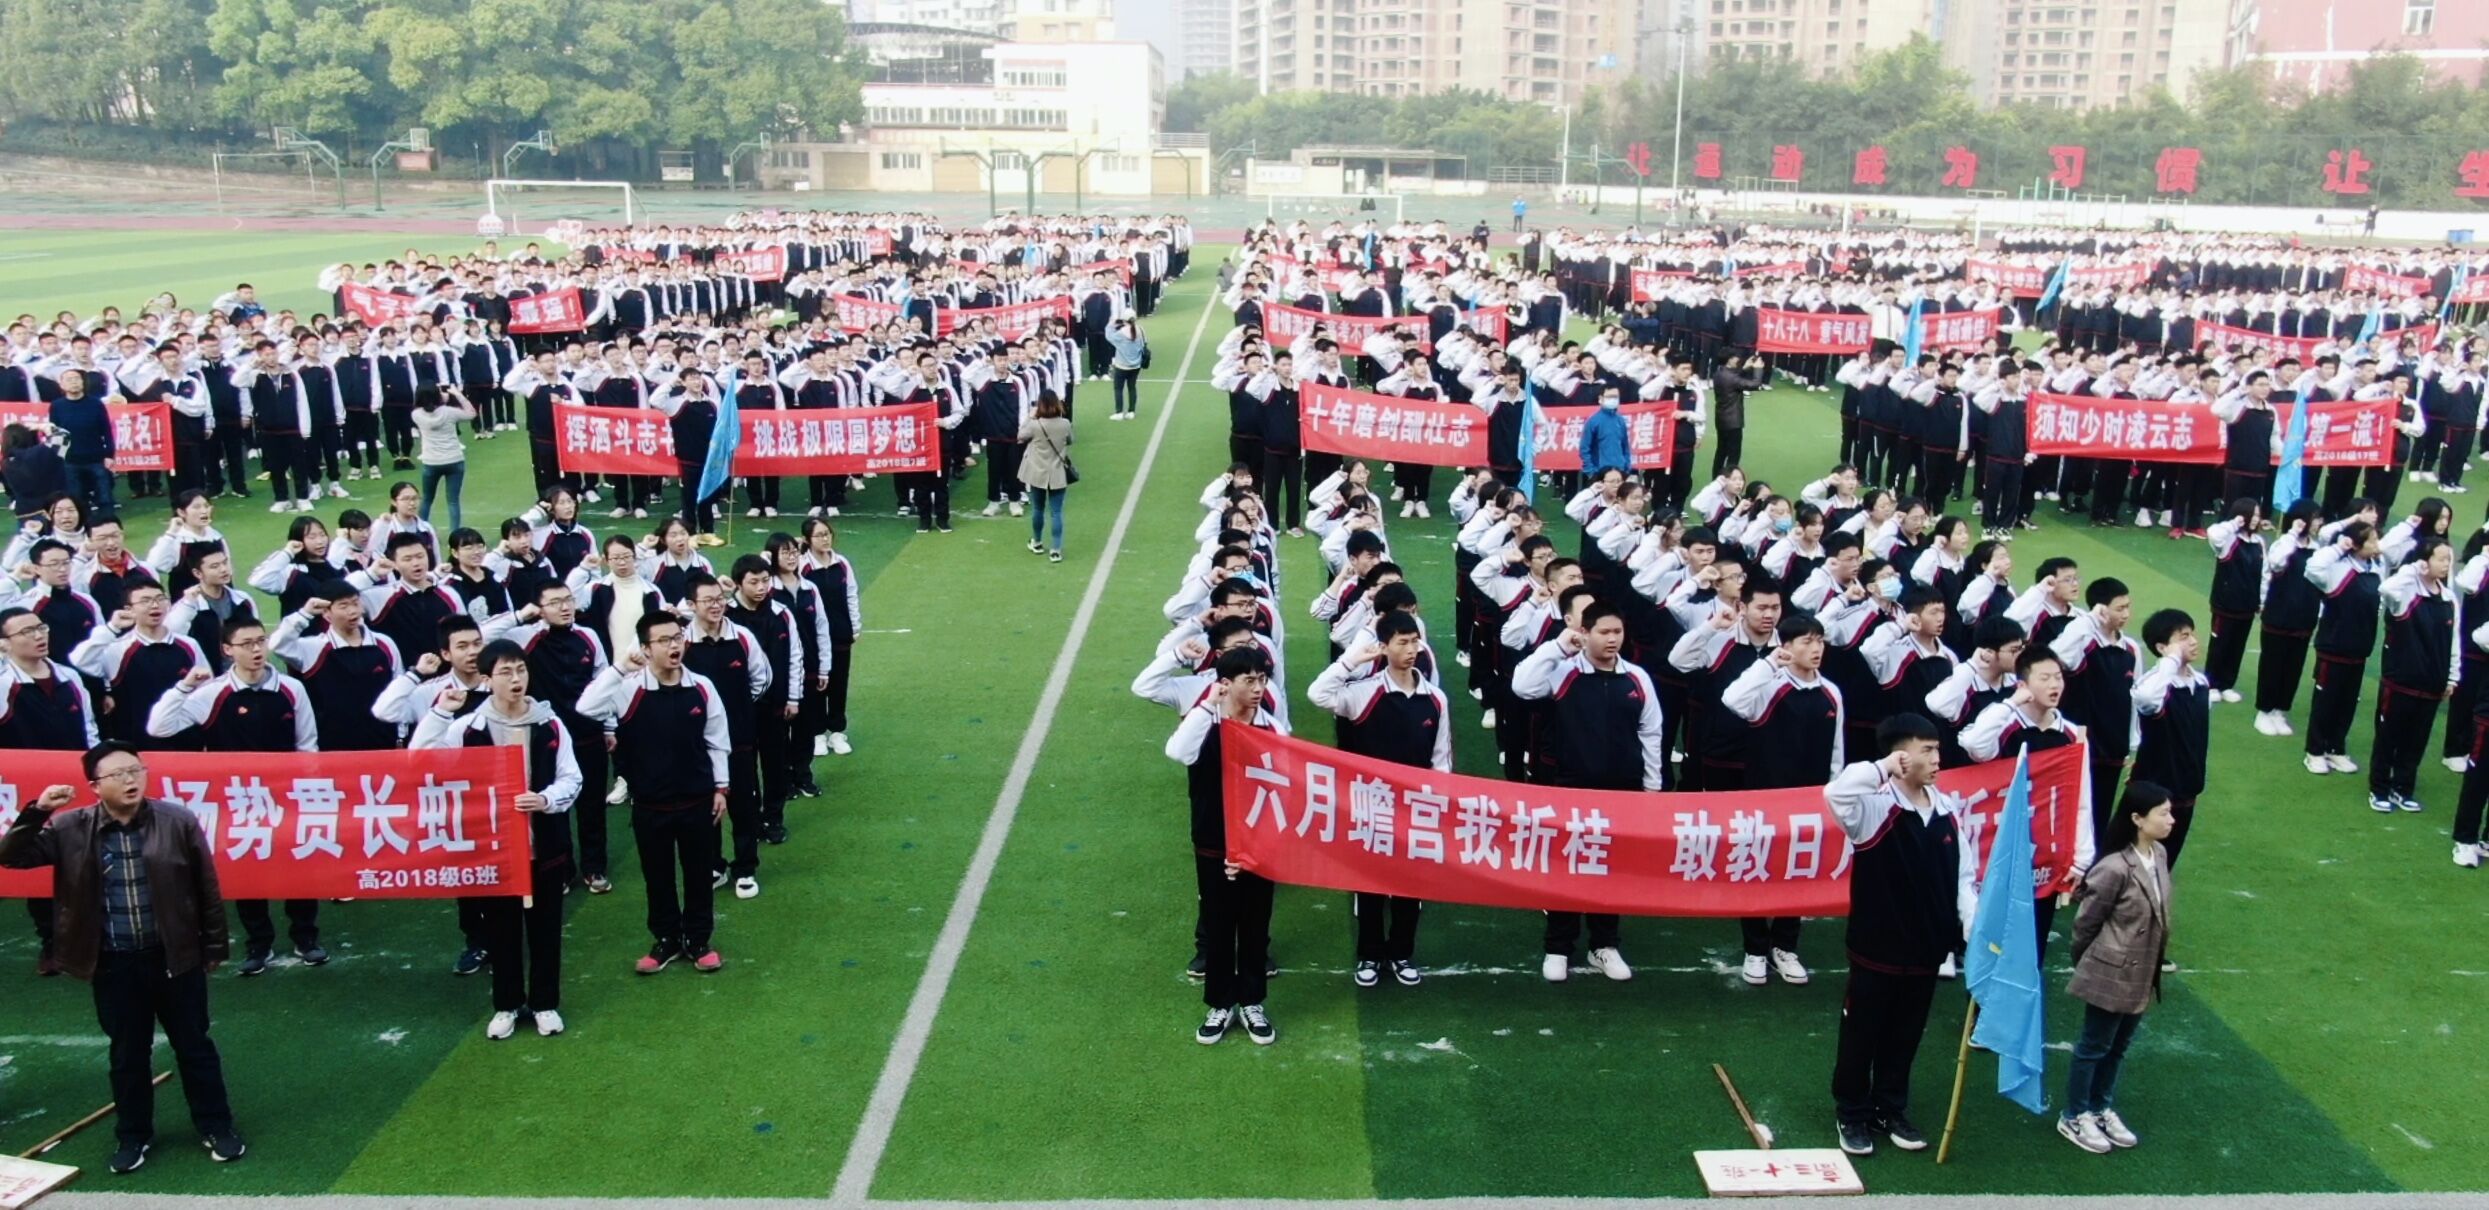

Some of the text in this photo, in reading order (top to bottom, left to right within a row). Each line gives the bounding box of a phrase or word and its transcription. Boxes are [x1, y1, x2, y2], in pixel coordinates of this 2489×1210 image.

[752, 415, 926, 458] 挑战极限圆梦想！
[1307, 394, 1473, 448] 十年磨剑酬壮志
[2033, 402, 2194, 451] 须知少时凌云志
[1244, 751, 1612, 876] 六月蟾宫我折桂
[355, 865, 500, 890] 高2018级6班
